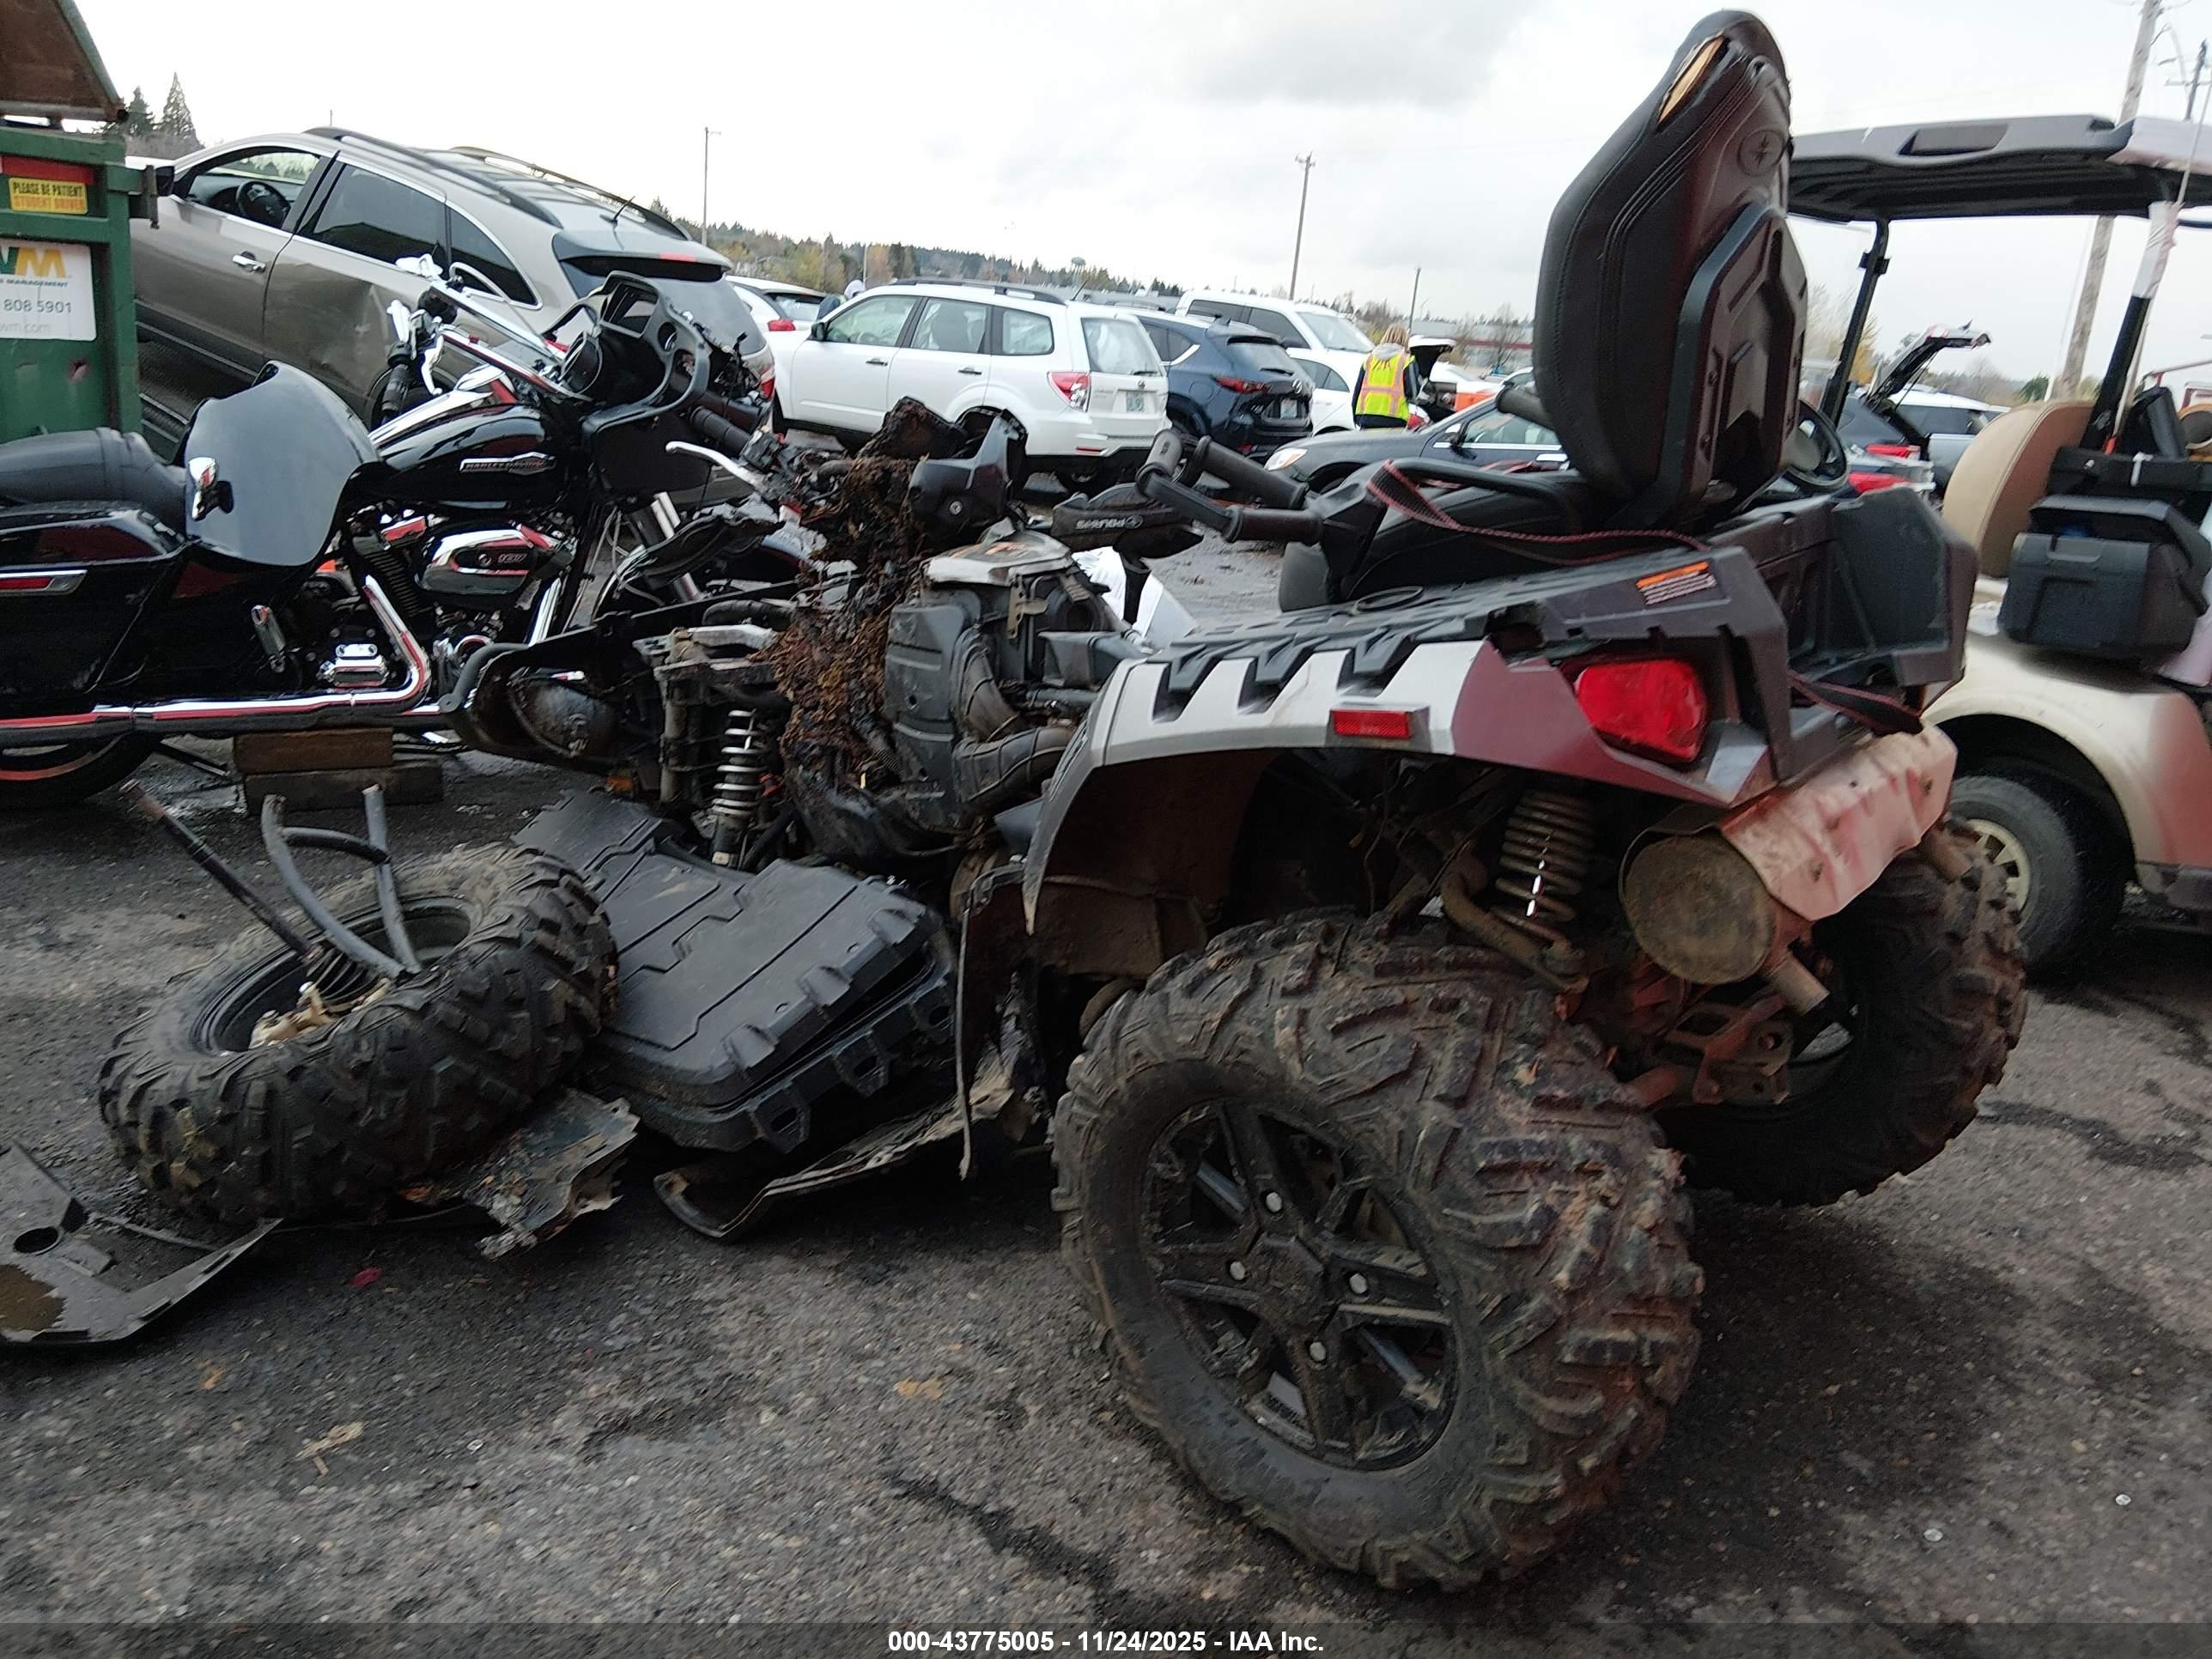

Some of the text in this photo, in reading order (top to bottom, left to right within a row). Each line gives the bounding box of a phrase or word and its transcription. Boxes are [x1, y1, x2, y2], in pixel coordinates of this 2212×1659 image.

[13, 181, 83, 197] PLEASE BE PATIENT
[3, 298, 72, 313] 808 5901
